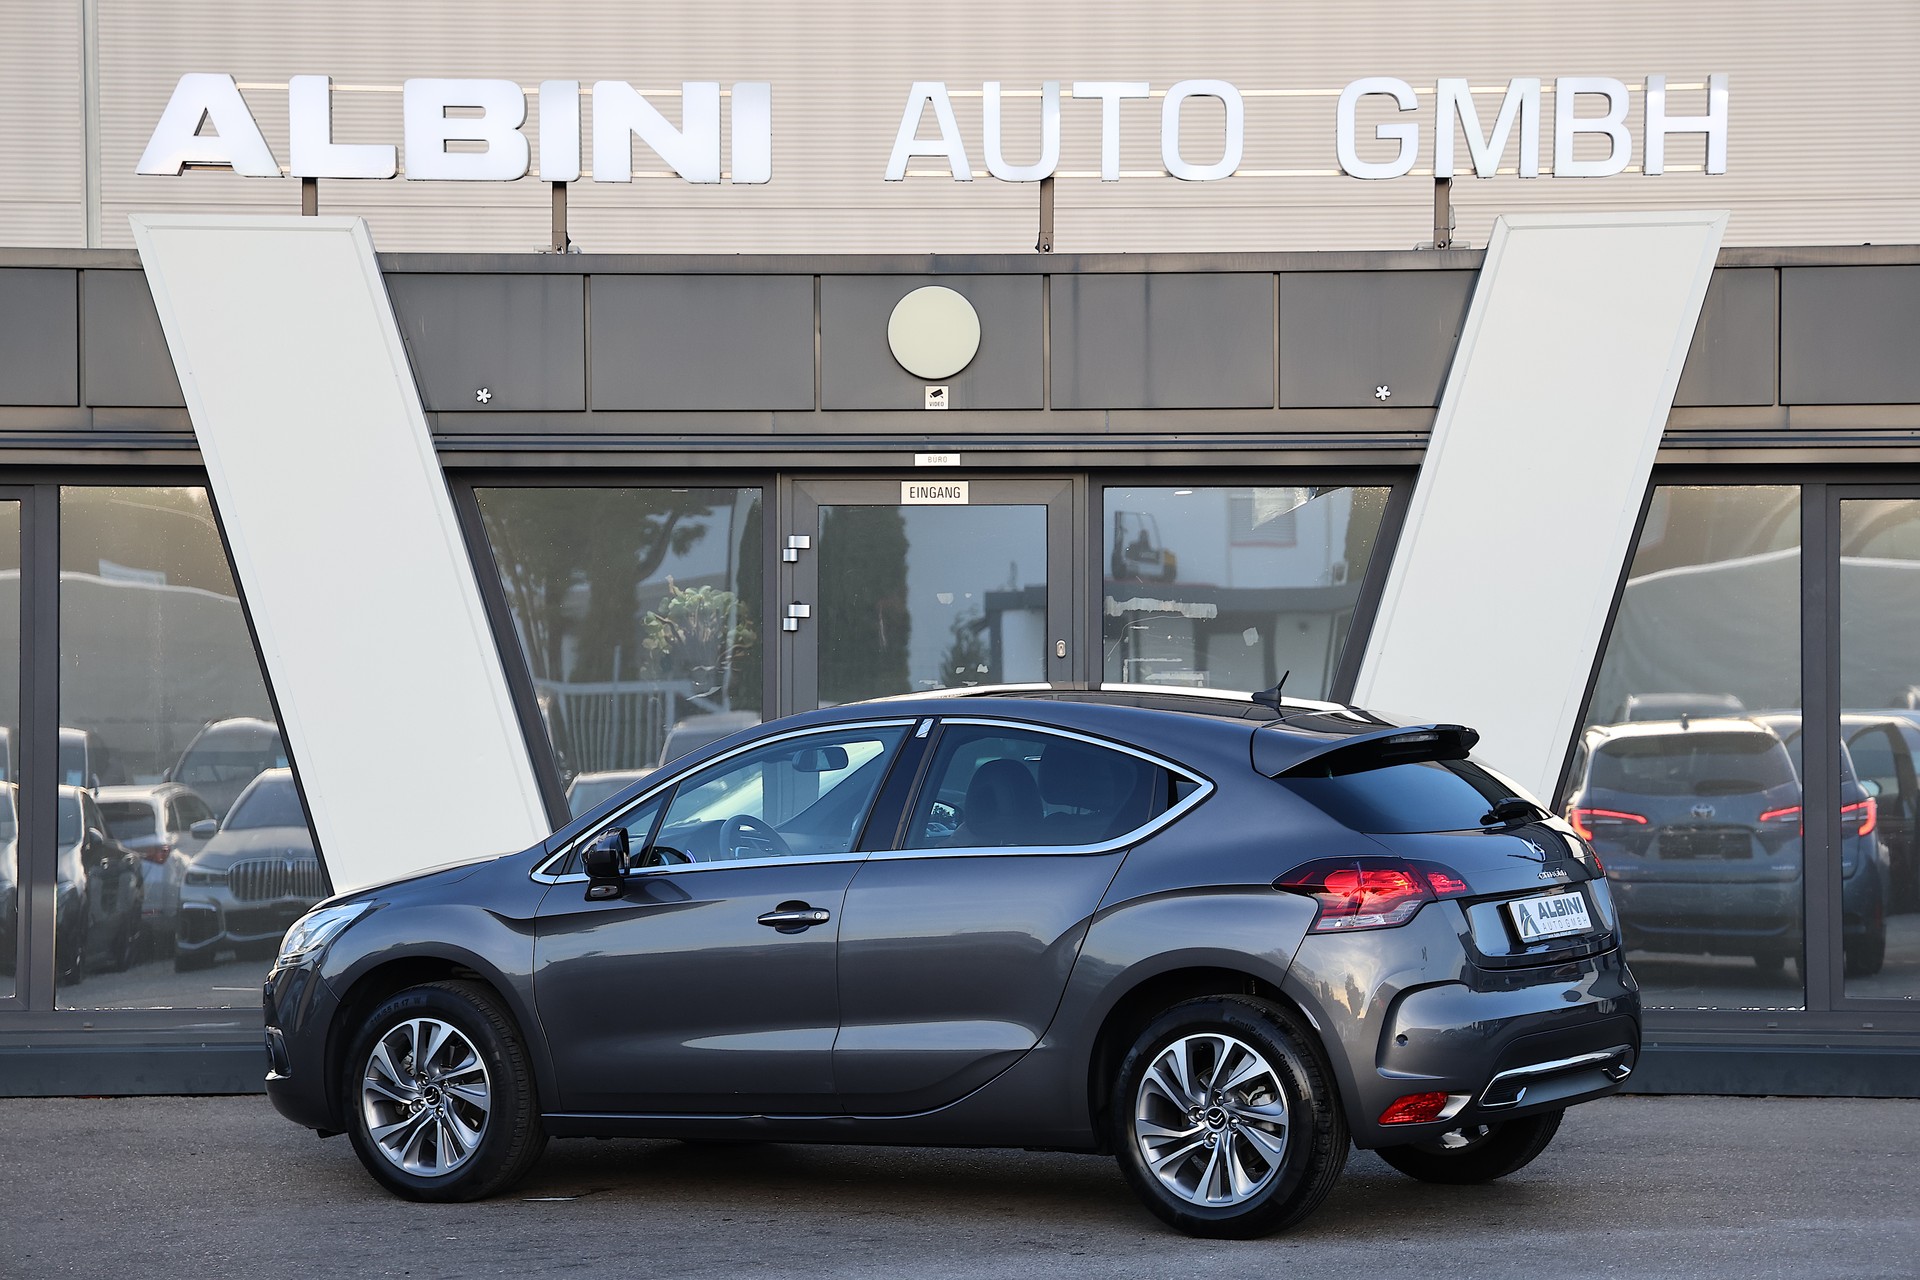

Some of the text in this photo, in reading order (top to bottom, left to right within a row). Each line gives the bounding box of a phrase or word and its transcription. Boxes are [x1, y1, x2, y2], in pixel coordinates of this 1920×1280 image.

[135, 73, 1730, 185] ALBINI AUTO GMBH
[927, 455, 948, 463] BÜRO
[909, 486, 961, 499] EINGANG
[1537, 896, 1584, 920] ALBINI
